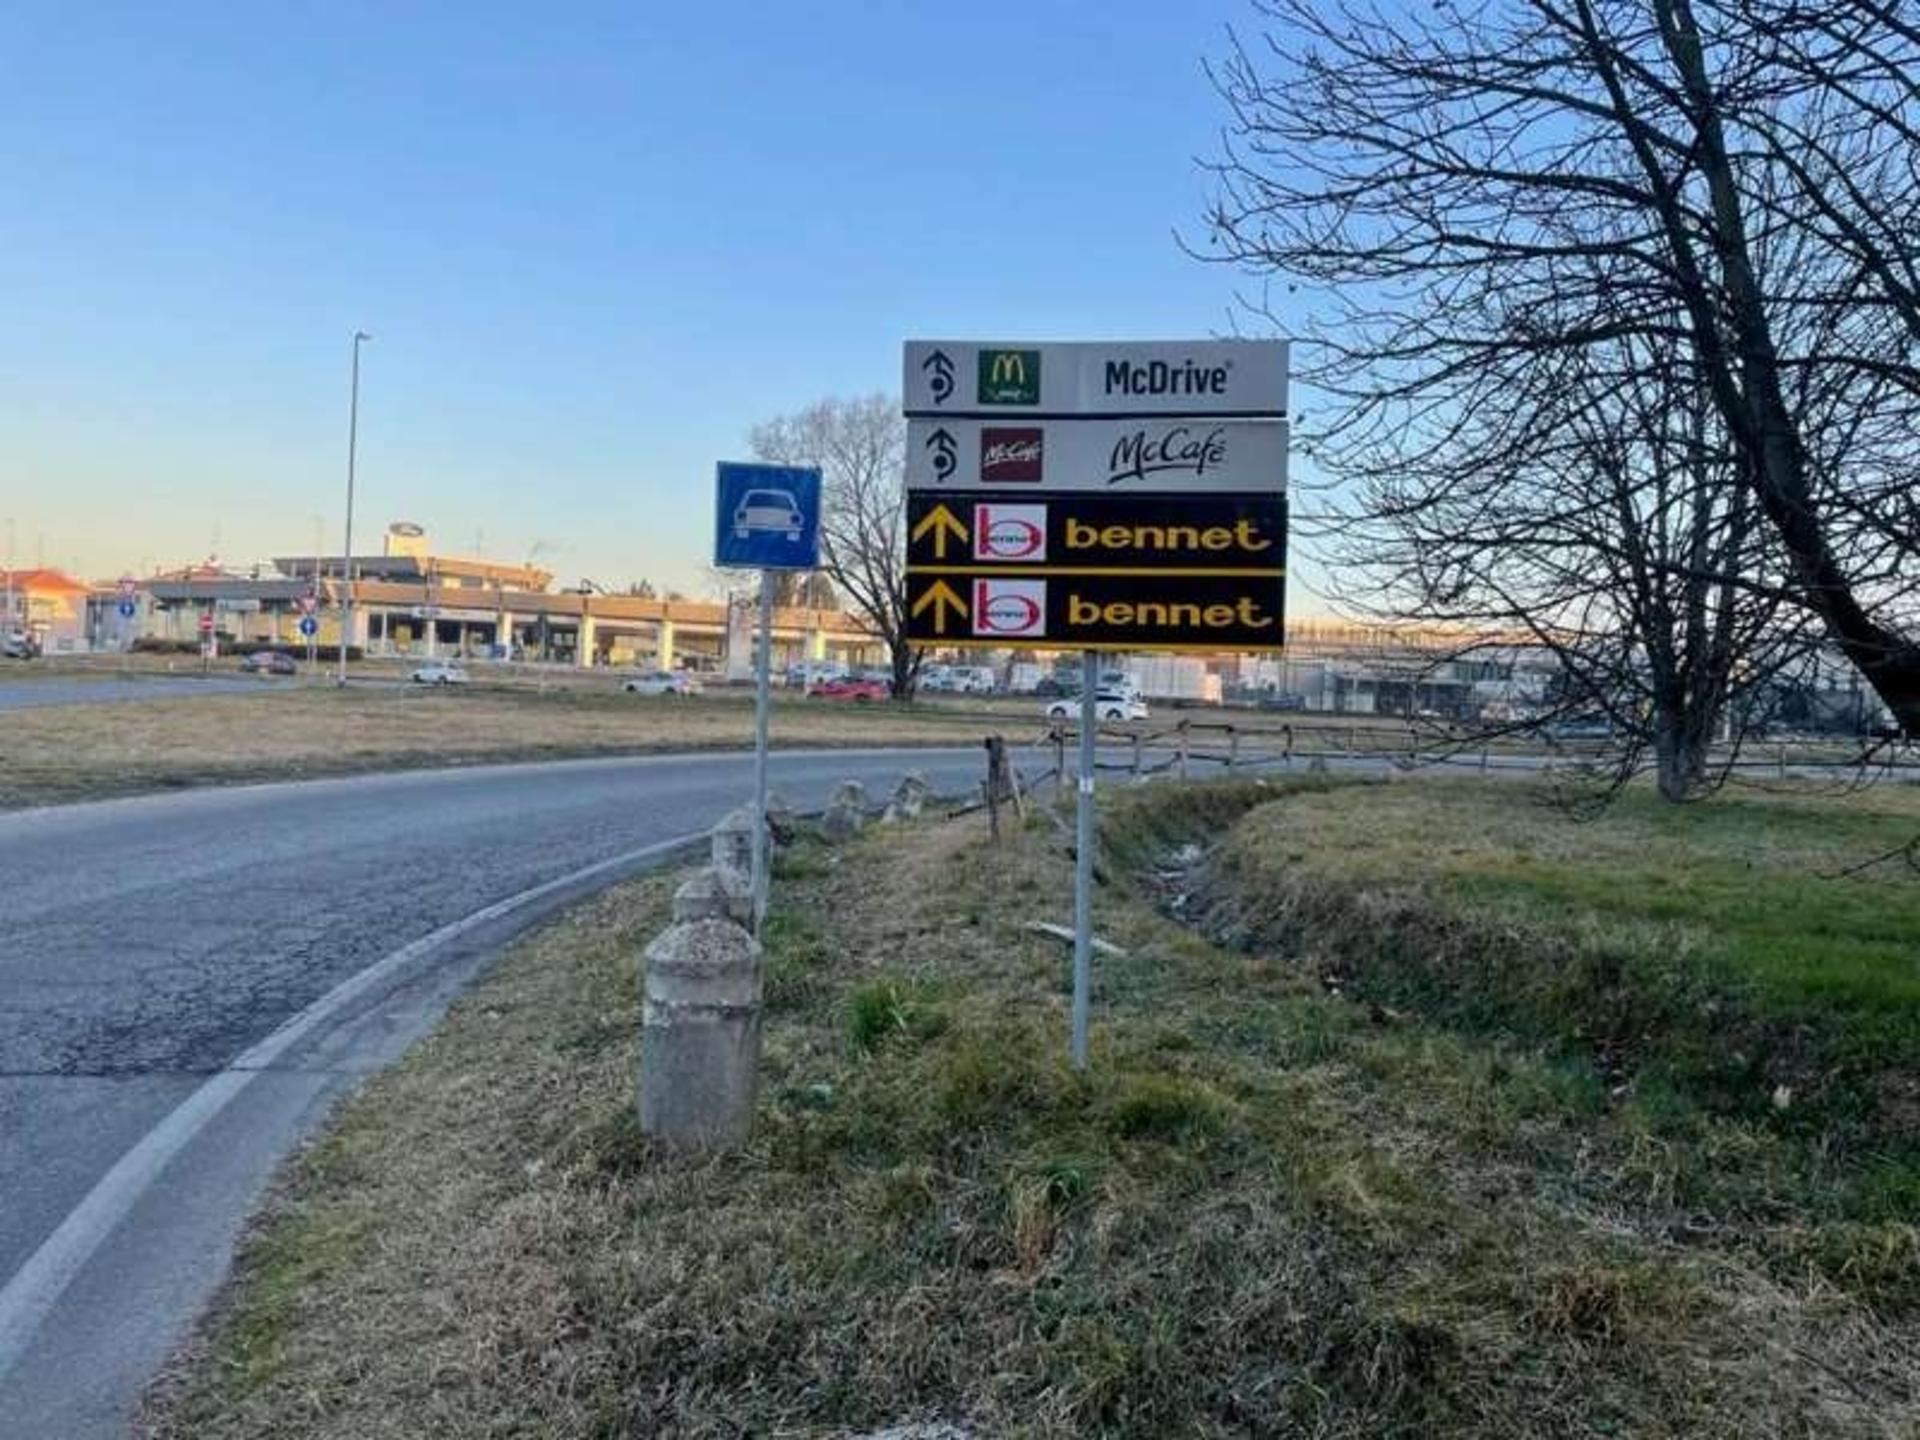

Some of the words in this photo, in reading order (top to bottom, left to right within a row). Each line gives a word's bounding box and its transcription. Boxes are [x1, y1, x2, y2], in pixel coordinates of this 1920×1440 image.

[1105, 359, 1227, 395] McDrive
[1108, 427, 1226, 482] McCafé
[1065, 517, 1273, 552] bennet
[1068, 593, 1273, 628] bennet
